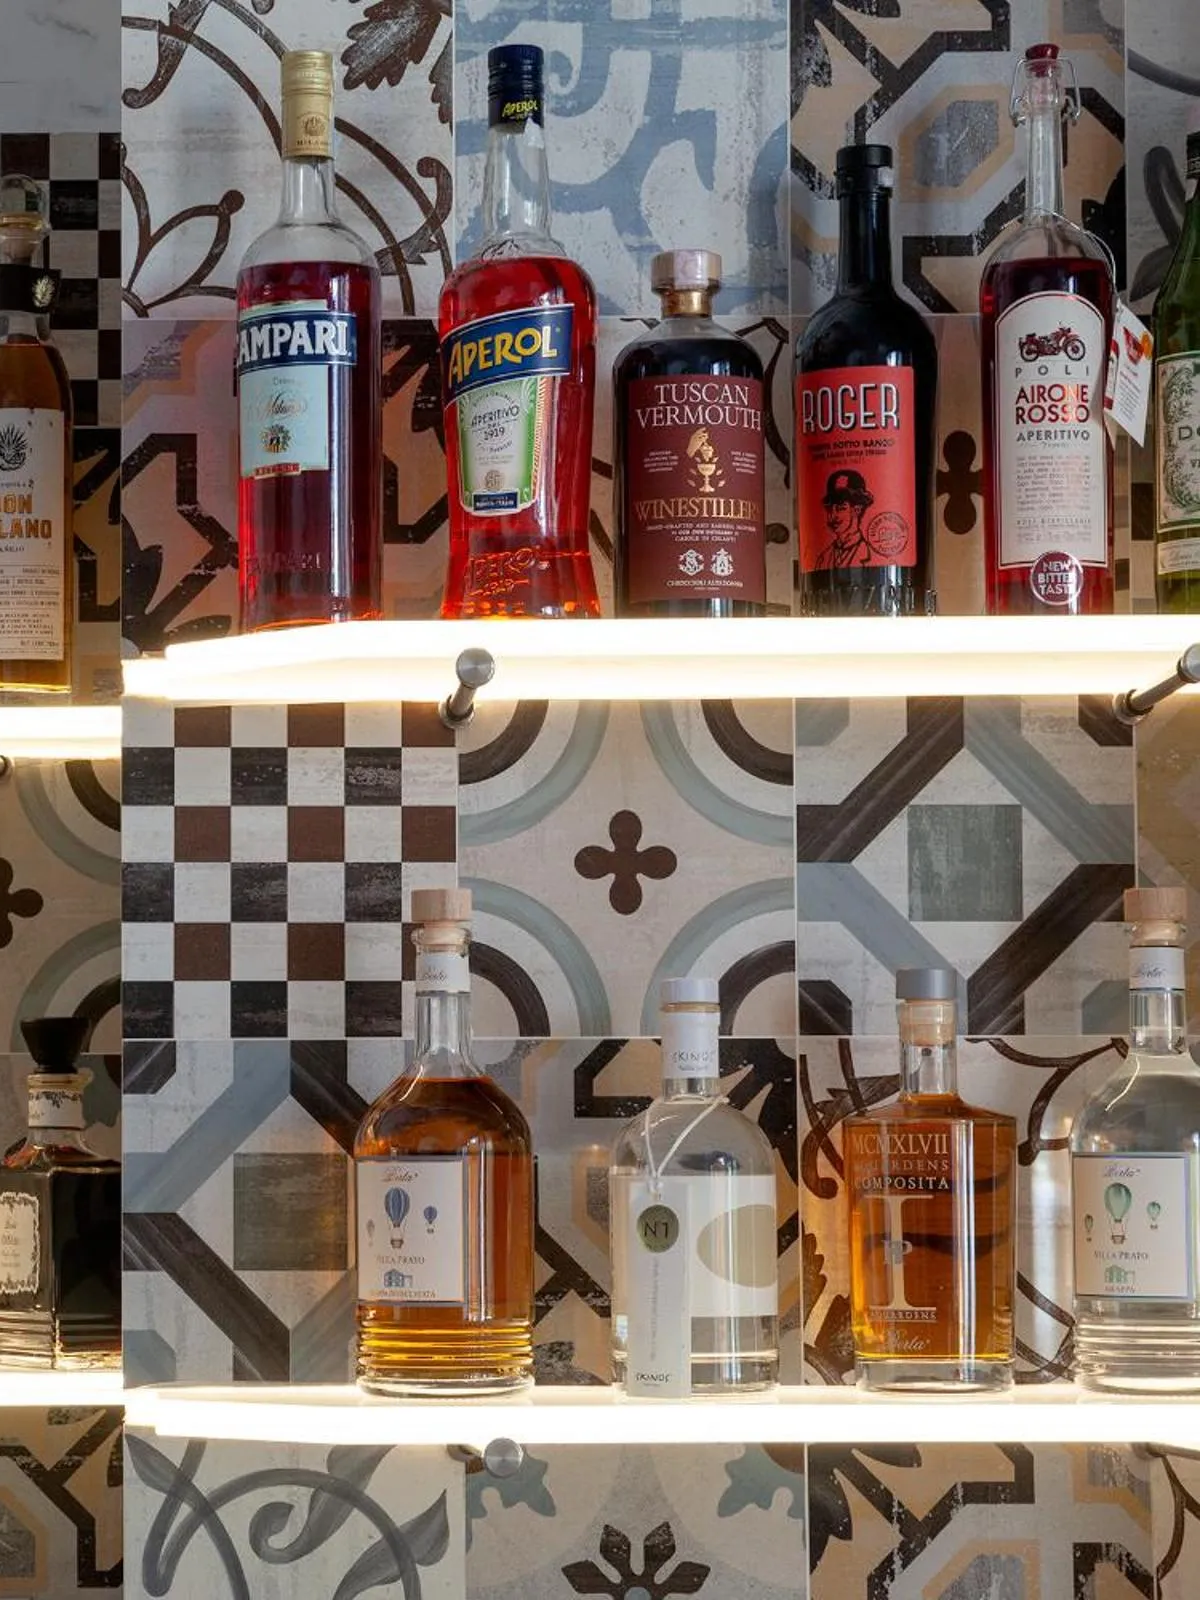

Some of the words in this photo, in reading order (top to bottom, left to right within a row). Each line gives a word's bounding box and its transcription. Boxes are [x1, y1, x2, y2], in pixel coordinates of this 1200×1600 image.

[237, 319, 349, 365] AMPARI
[448, 326, 558, 389] APEROL
[1015, 365, 1090, 379] POLI
[655, 382, 749, 406] TUSCAN
[1015, 384, 1089, 405] AIRONE
[471, 404, 520, 427] APERITIVO
[636, 404, 761, 431] VERMOUTH
[802, 383, 899, 434] ROGER
[1015, 404, 1090, 425] ROSSO
[484, 426, 505, 441] 1919
[1016, 430, 1091, 442] APERITIVO
[636, 497, 760, 520] WINESTILLER
[1042, 561, 1069, 572] NEW
[1038, 572, 1076, 585] BITTE
[1039, 584, 1074, 597] TAST
[1119, 1250, 1148, 1260] PRATO
